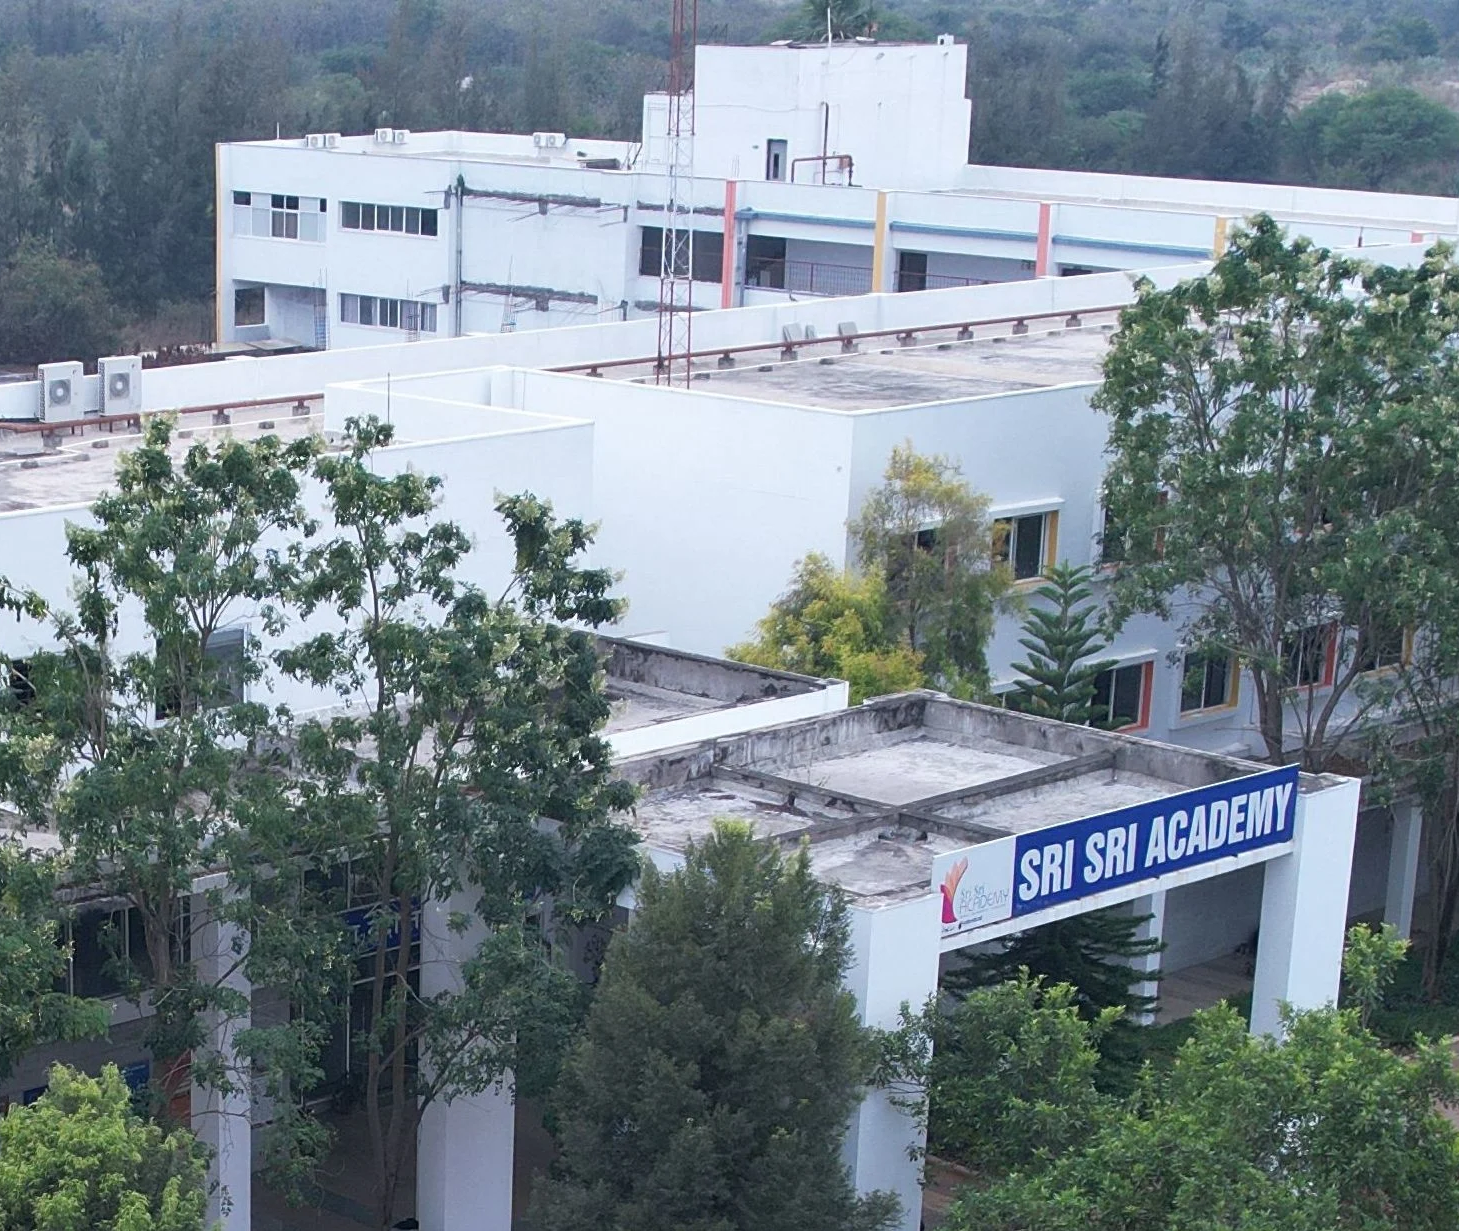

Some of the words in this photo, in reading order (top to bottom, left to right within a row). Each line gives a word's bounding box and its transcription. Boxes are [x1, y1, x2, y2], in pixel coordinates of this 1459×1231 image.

[1019, 840, 1074, 901] SRI
[1083, 822, 1138, 884] SRI
[1145, 781, 1293, 868] ACADEMY
